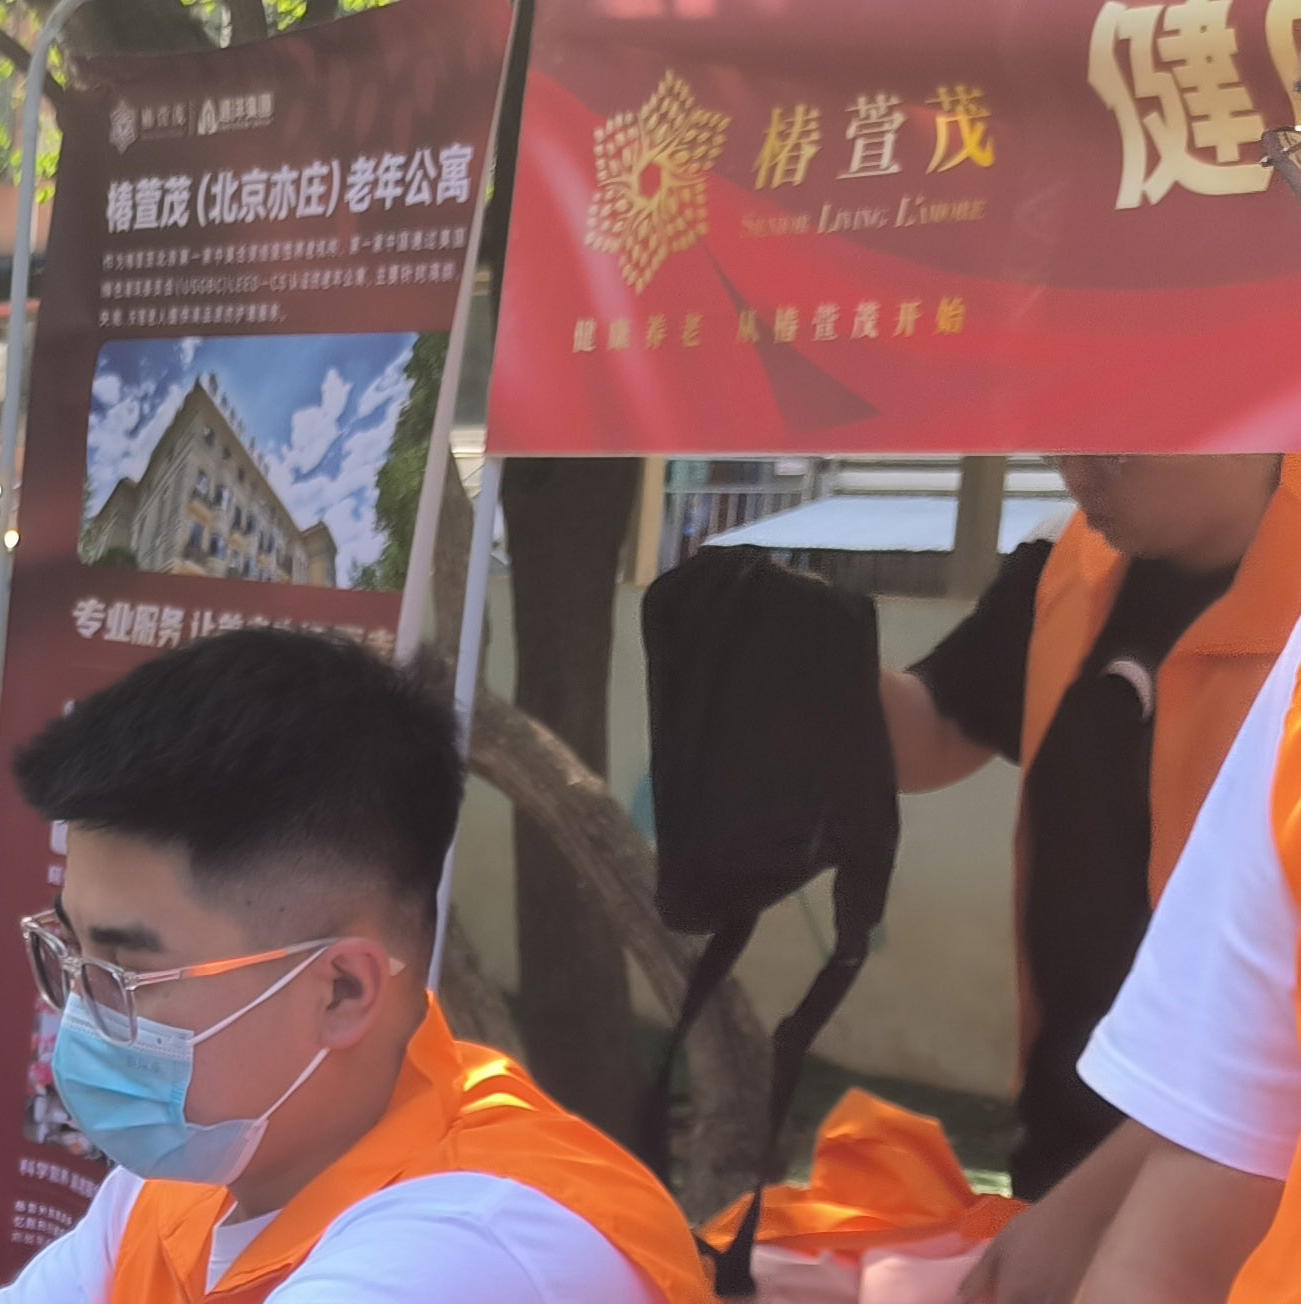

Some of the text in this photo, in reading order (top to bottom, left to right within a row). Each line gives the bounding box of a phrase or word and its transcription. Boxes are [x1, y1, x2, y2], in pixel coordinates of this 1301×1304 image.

[752, 83, 996, 191] 椿萱茂
[1088, 0, 1301, 210] 健
[572, 295, 967, 354] 健康养老 从椿萱茂开始
